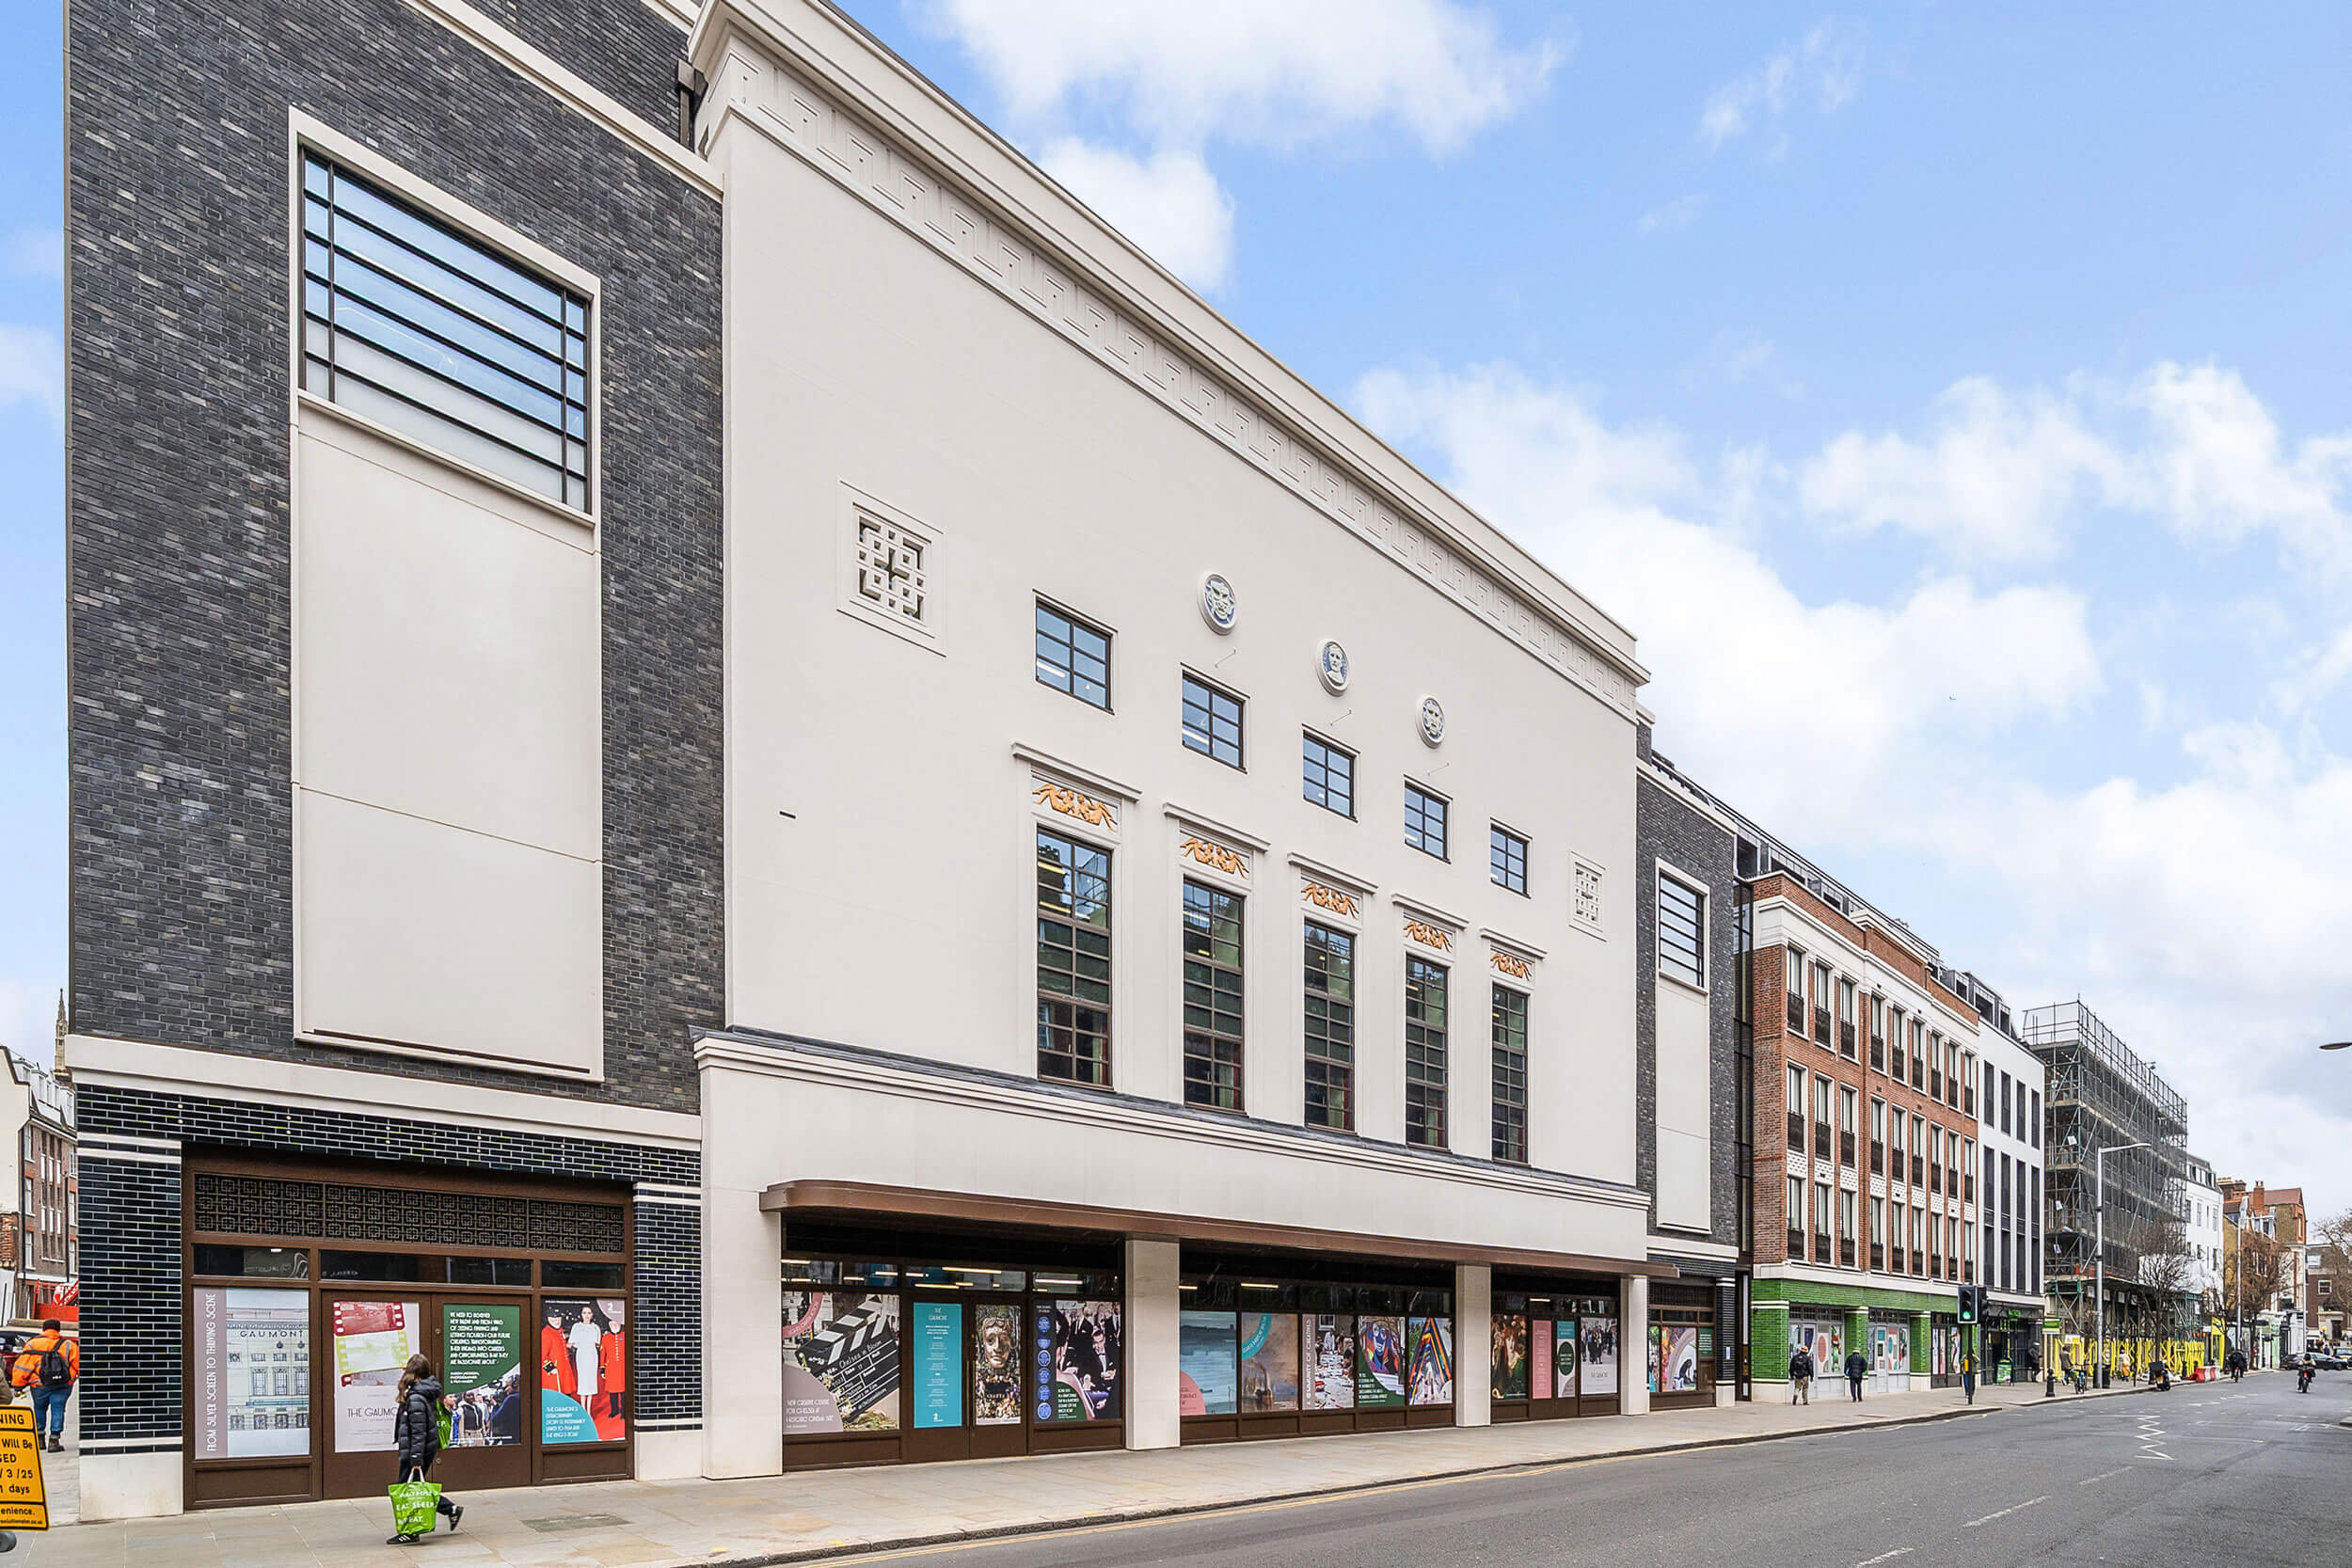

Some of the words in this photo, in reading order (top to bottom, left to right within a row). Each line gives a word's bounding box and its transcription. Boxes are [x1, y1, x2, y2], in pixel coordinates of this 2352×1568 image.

[205, 1294, 216, 1319] SCENE
[206, 1323, 216, 1356] THRIVING
[207, 1358, 216, 1370] TO
[207, 1371, 216, 1401] SCREEN
[207, 1403, 216, 1428] SILVER
[348, 1407, 362, 1417] THE
[364, 1407, 397, 1417] GAUMO
[2, 1439, 20, 1449] Will
[23, 1439, 33, 1449] Be
[207, 1429, 216, 1452] FROM
[9, 1484, 30, 1496] days
